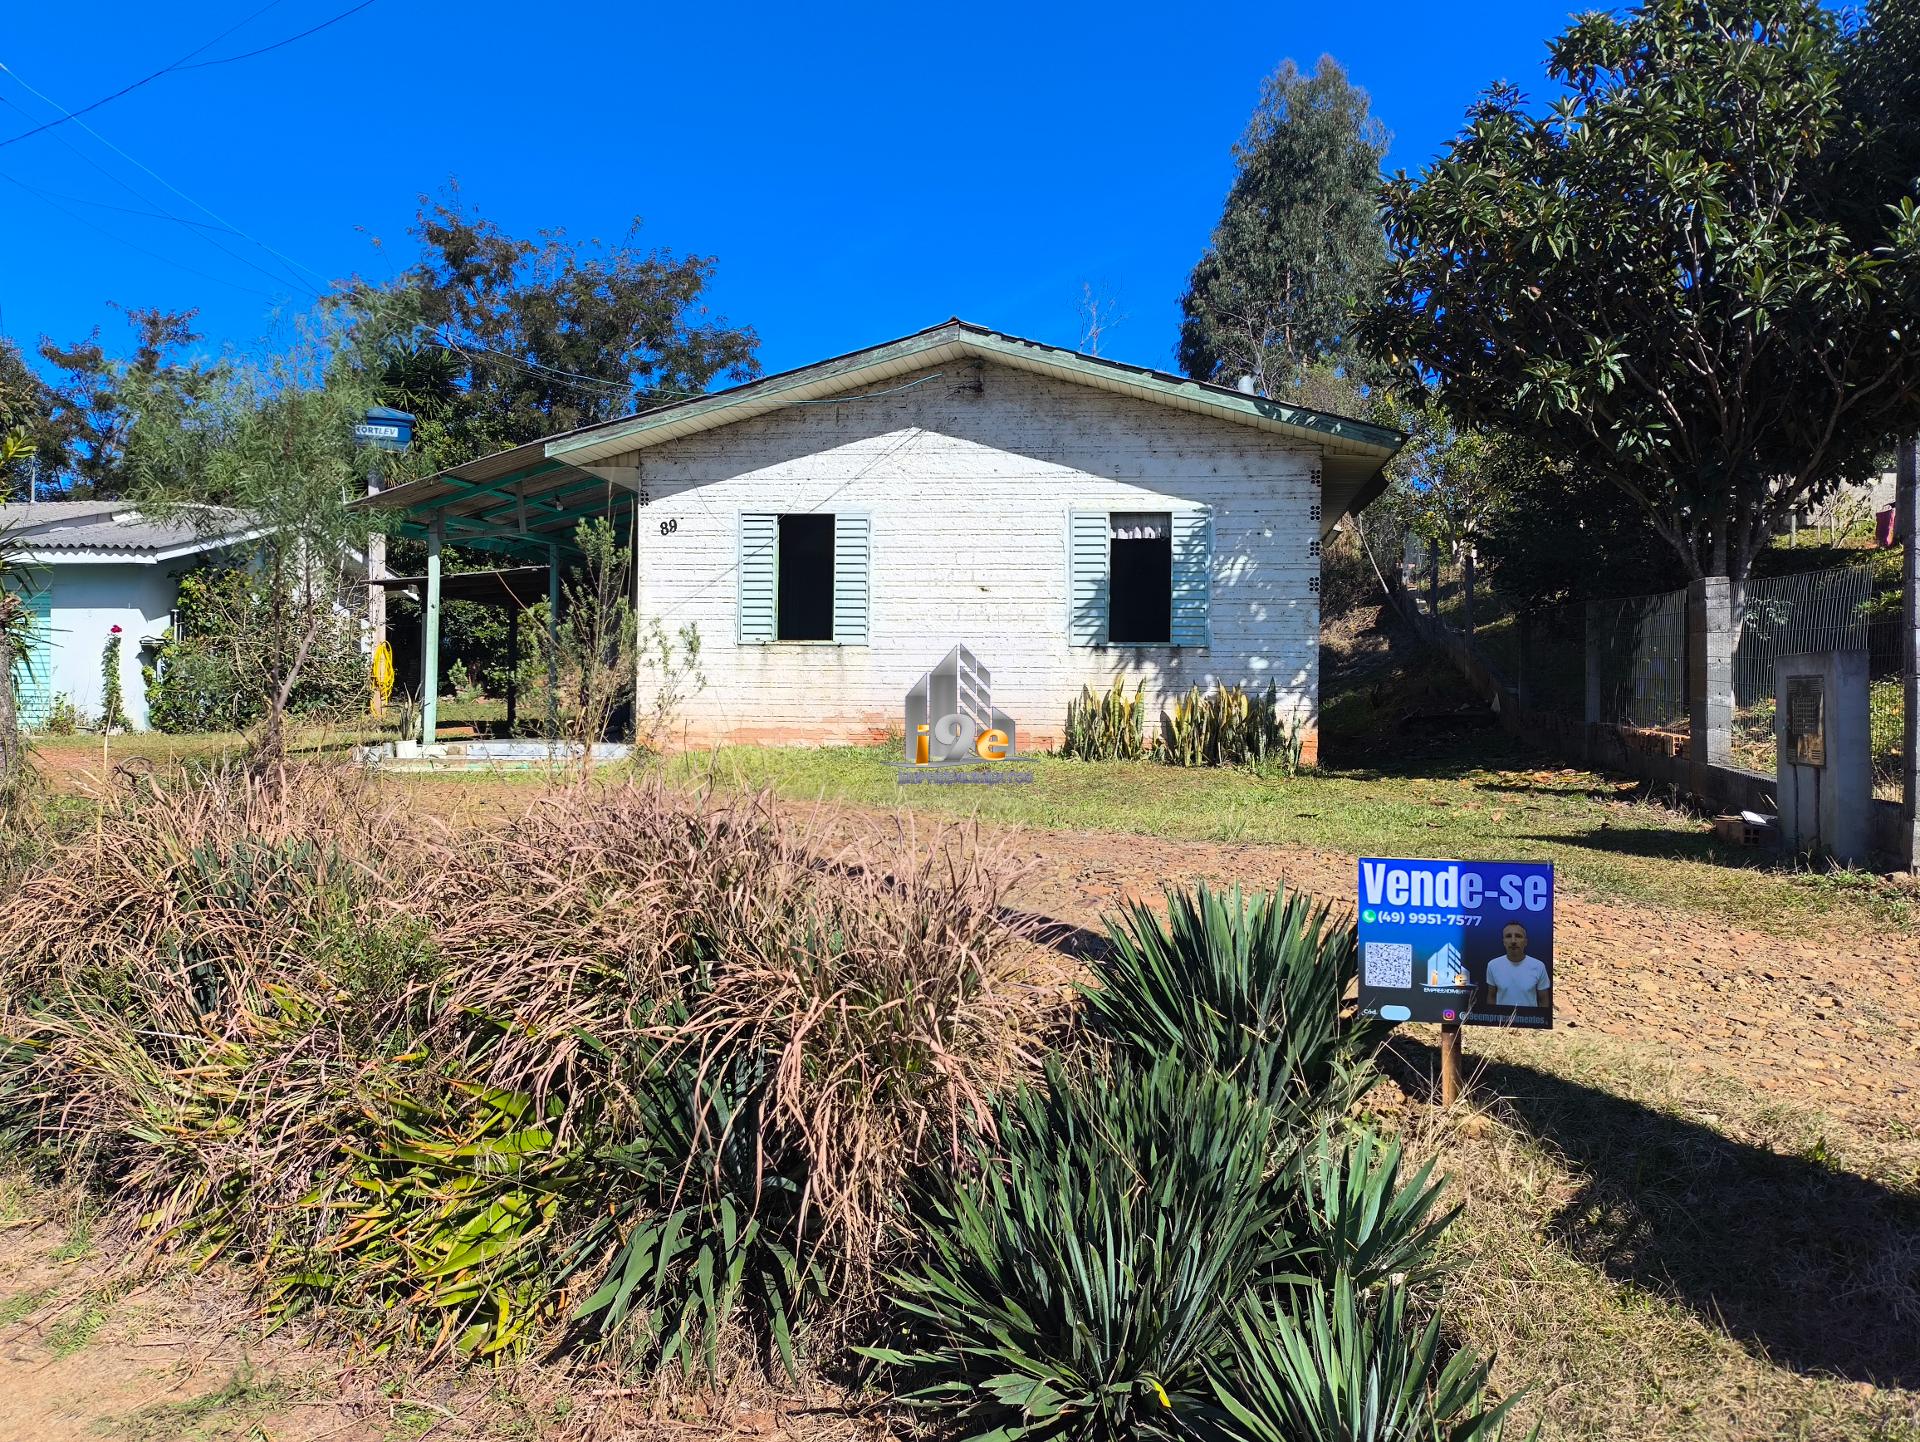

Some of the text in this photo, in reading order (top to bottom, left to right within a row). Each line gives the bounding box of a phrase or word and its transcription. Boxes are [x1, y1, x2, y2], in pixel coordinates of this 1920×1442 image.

[660, 518, 677, 536] 89
[1362, 862, 1547, 912] Vende-se
[1378, 911, 1482, 927] (49) 9951-7577
